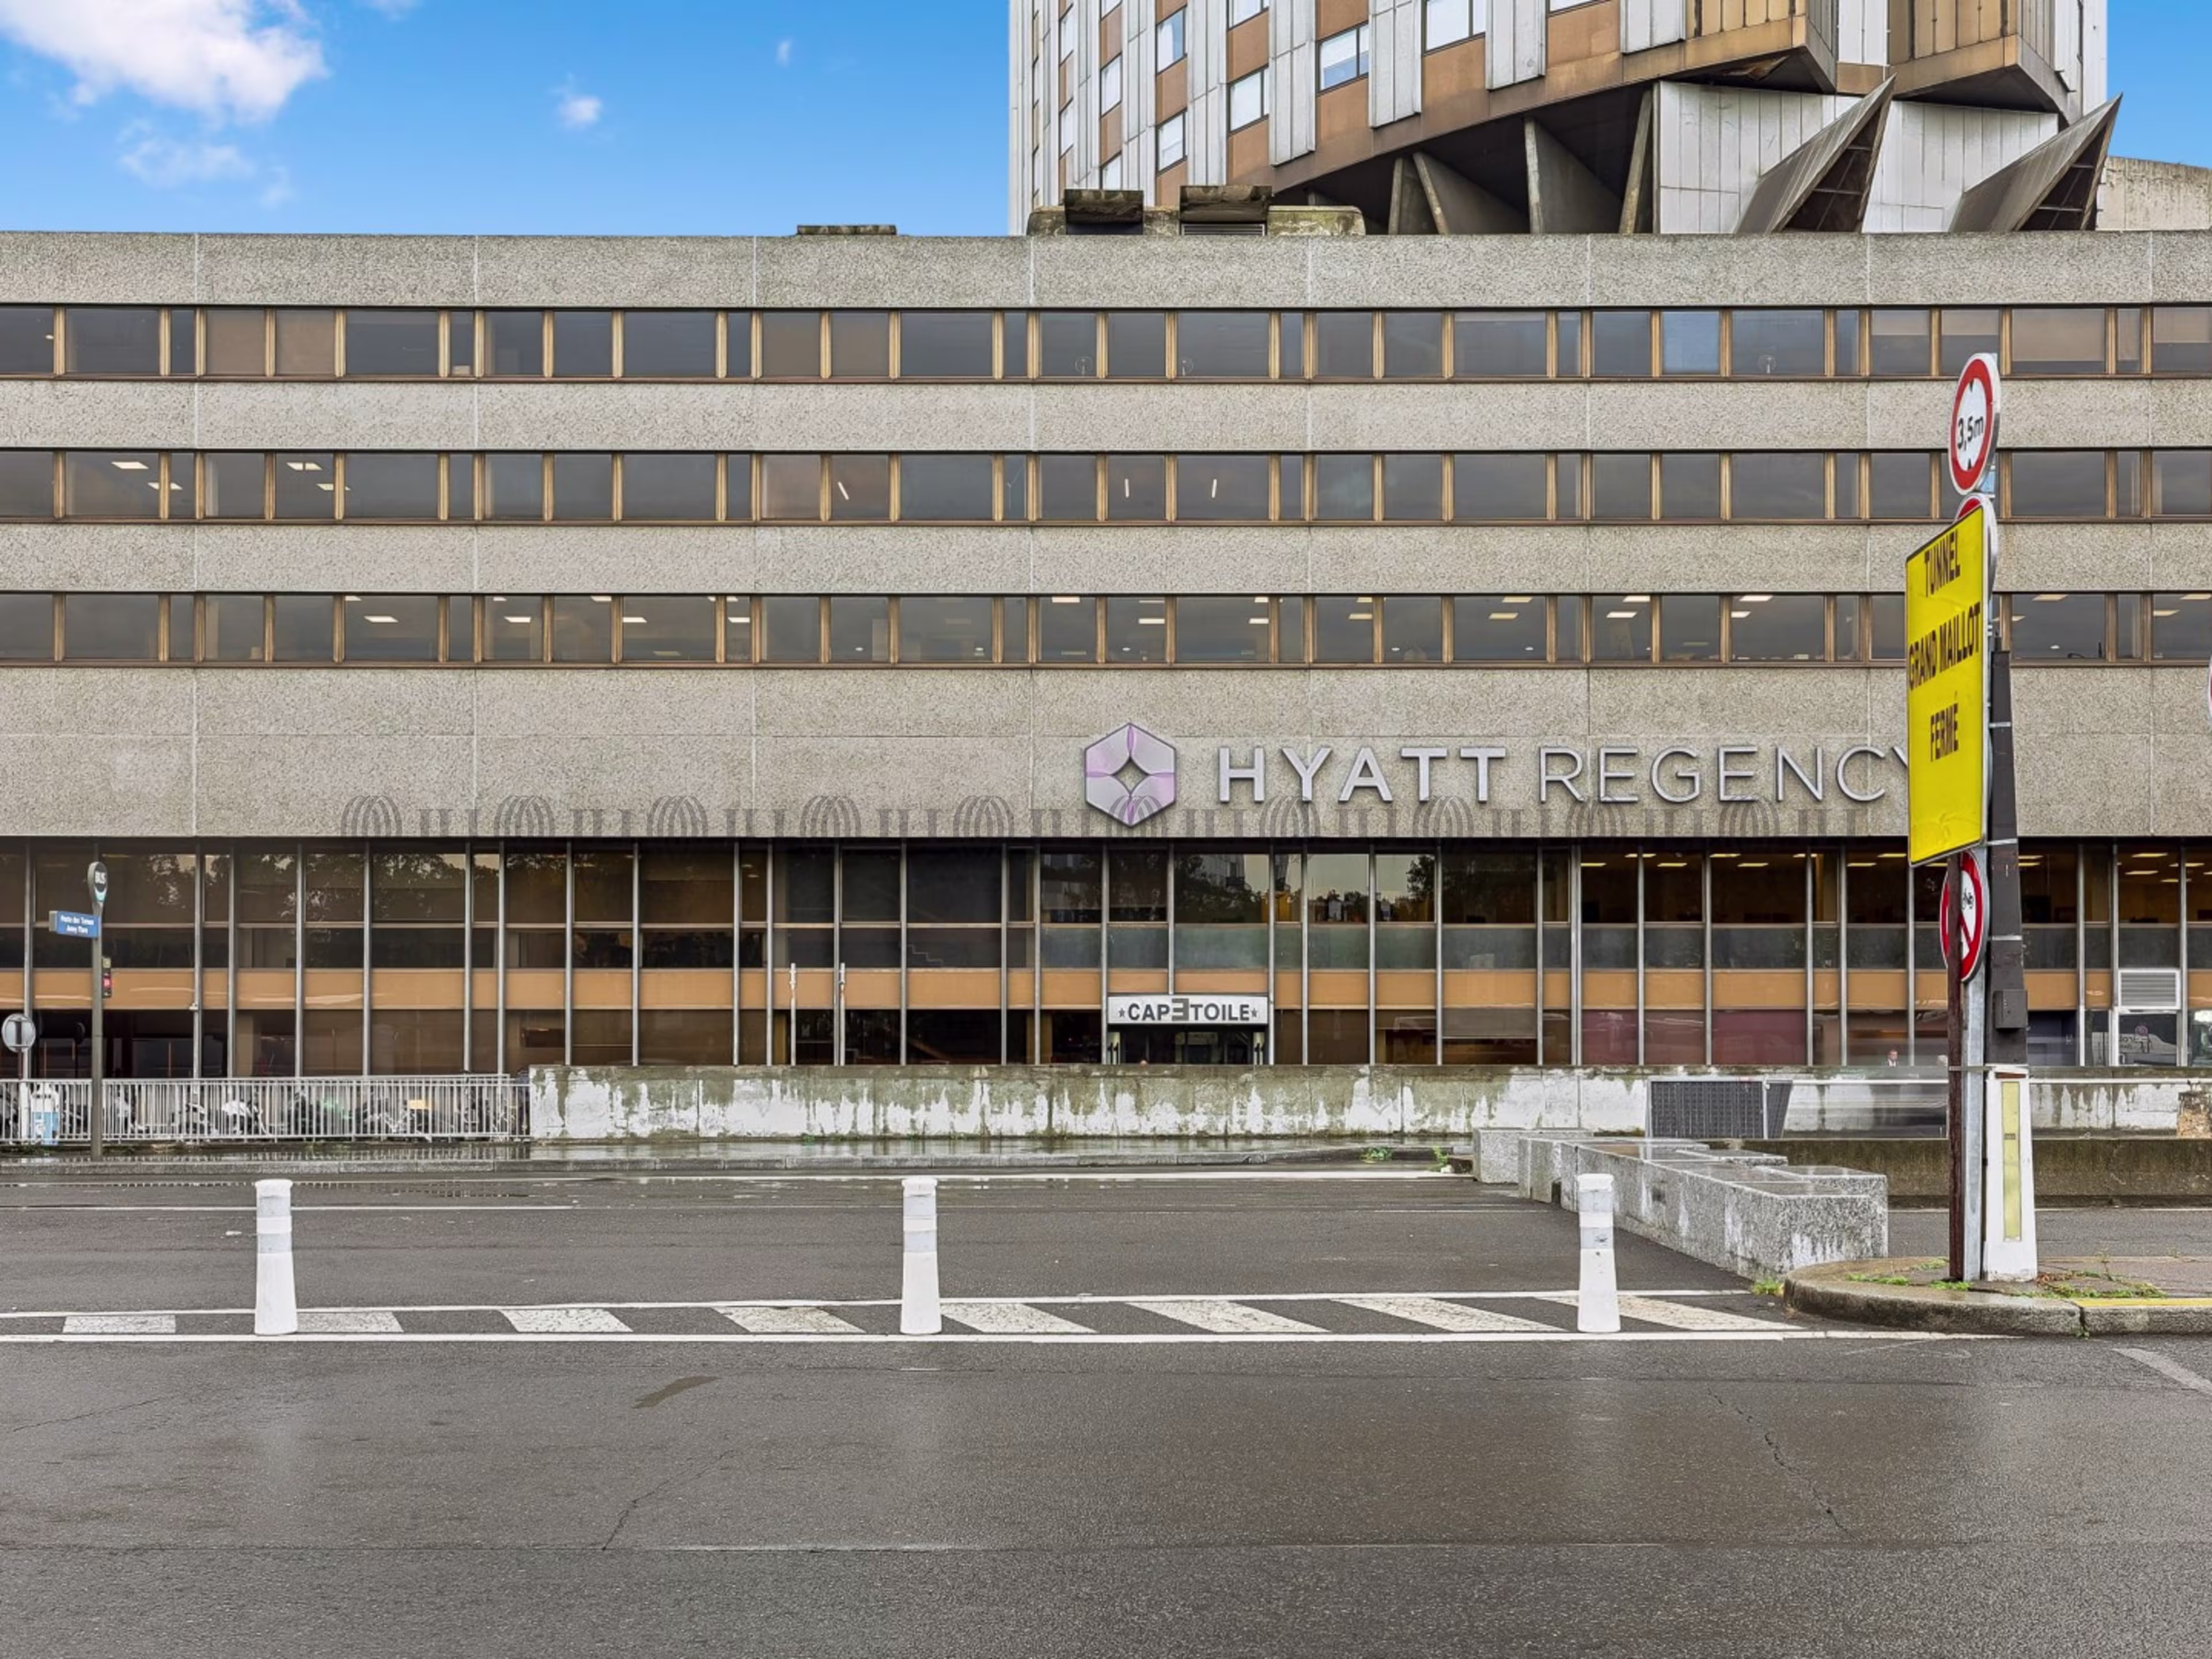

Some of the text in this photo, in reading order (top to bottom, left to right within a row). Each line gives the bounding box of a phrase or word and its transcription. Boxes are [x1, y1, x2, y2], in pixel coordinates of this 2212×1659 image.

[1957, 415, 1984, 451] 3,5m
[1924, 528, 1961, 598] TUNNEL
[1908, 602, 1981, 692] GRAND MAILLOT
[1218, 745, 1908, 802] HYATT REGENC
